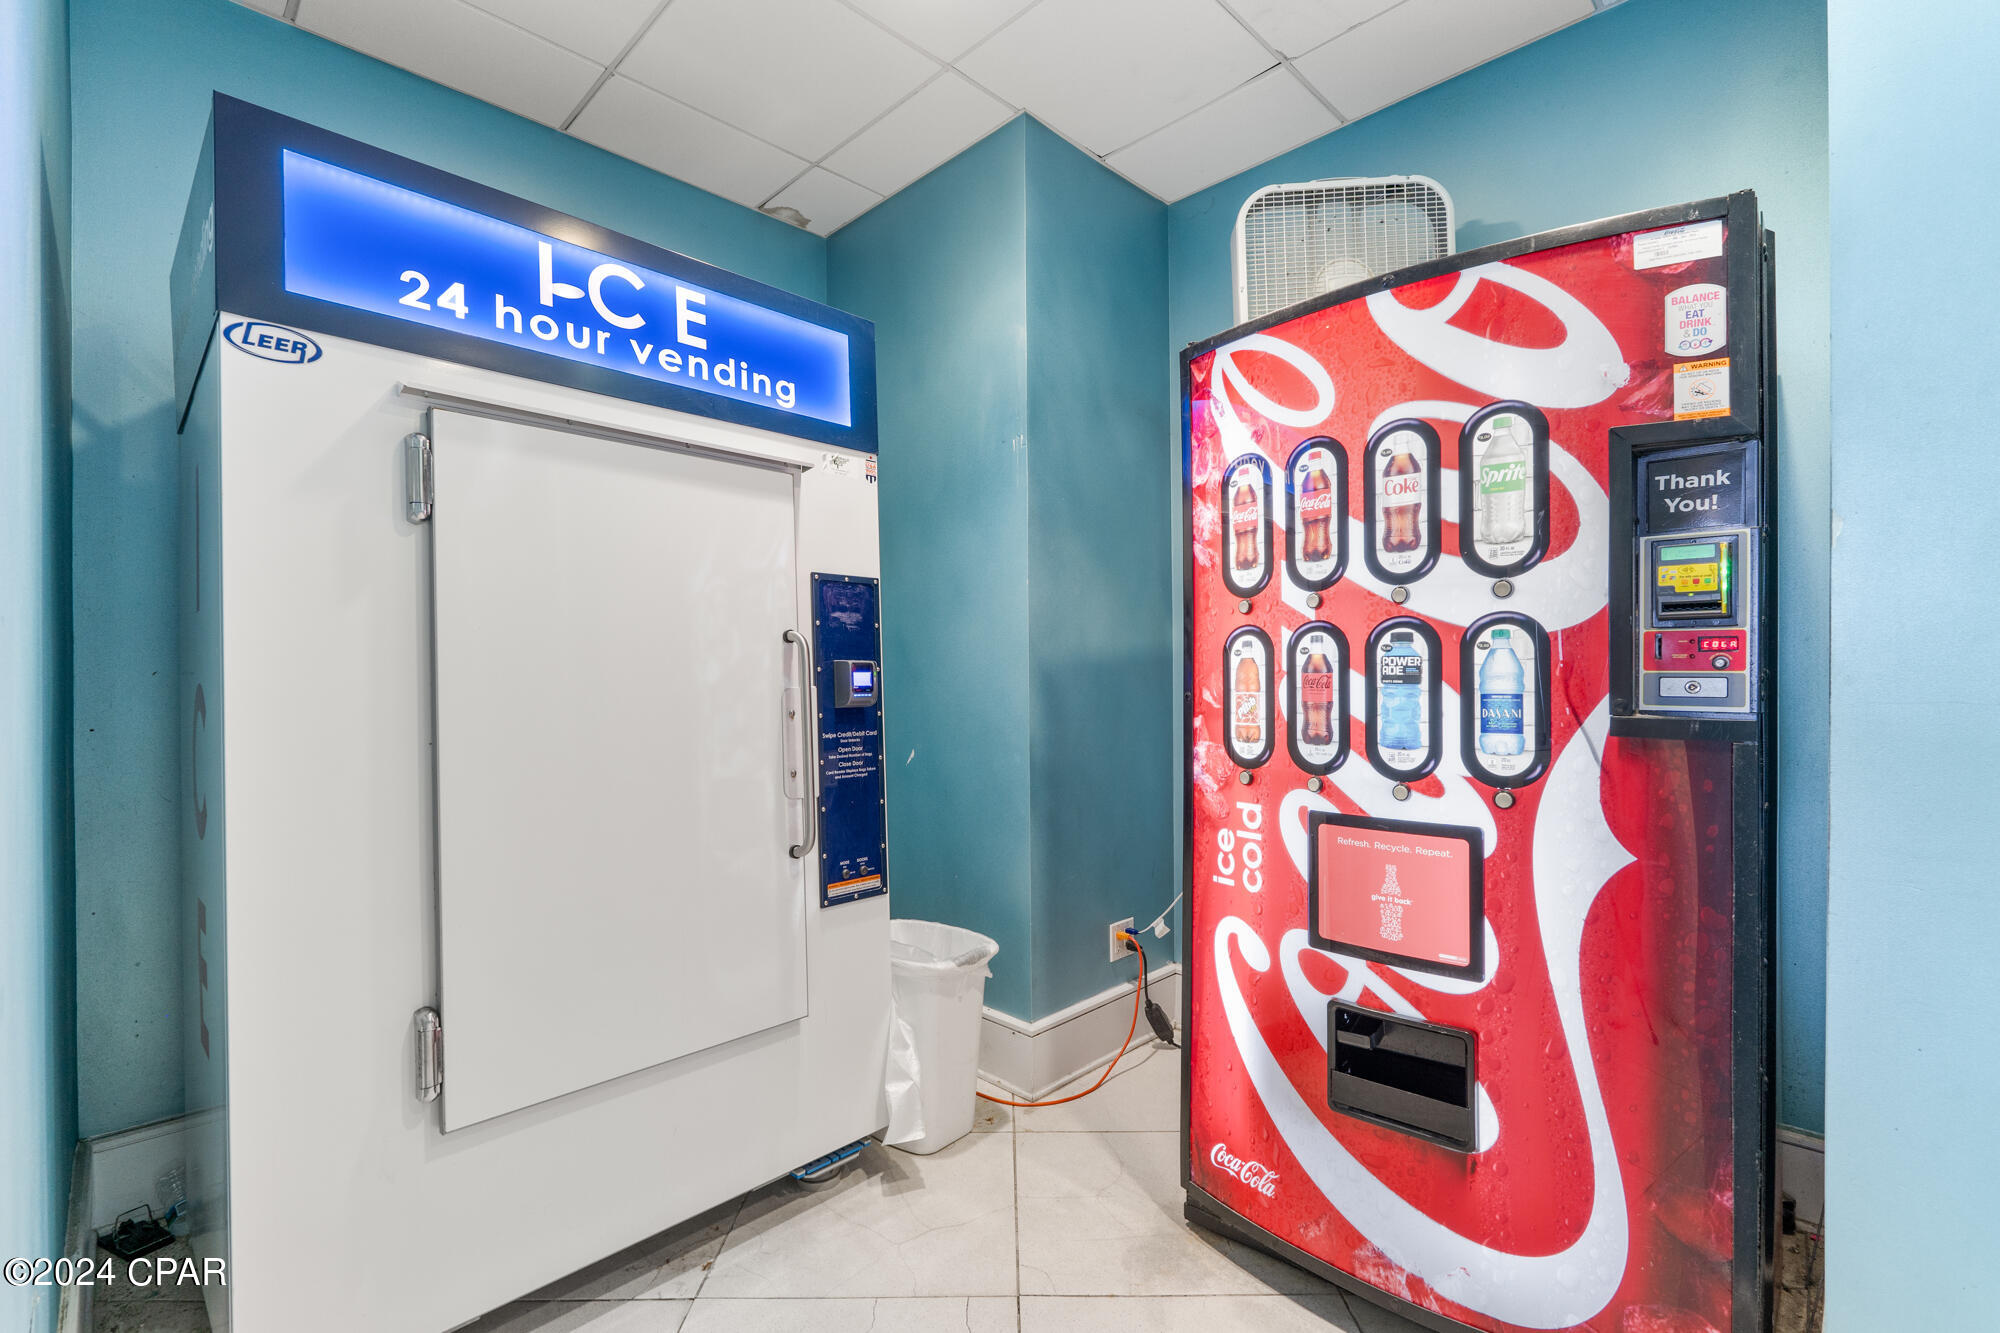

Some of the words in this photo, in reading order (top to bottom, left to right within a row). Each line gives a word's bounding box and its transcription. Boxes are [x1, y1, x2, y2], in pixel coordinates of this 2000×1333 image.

[538, 240, 708, 351] ICE
[1671, 290, 1721, 306] BALANCE
[1679, 317, 1712, 330] DRINK
[1685, 308, 1705, 320] EAT
[398, 269, 469, 320] 24
[495, 293, 611, 355] hour
[629, 338, 796, 409] vending
[1692, 326, 1707, 337] DO
[241, 322, 307, 363] LEER
[1690, 360, 1727, 369] WARNING
[1480, 463, 1526, 489] Sprite
[1654, 469, 1732, 491] Thank
[1384, 478, 1419, 497] Coke
[1299, 493, 1331, 512] Coca-Cola
[1664, 494, 1719, 513] You!
[1382, 656, 1421, 666] POWER
[1382, 666, 1404, 676] ADE
[1303, 674, 1332, 689] Coca-Cola
[1482, 707, 1522, 719] DASANI
[822, 732, 836, 740] Swipe
[1236, 801, 1263, 894] cold
[1337, 836, 1371, 848] Refresh.
[1374, 841, 1413, 854] Recycle.
[1415, 846, 1454, 858] Repeat.
[1212, 827, 1236, 887] ice
[1371, 893, 1386, 901] give
[1394, 896, 1411, 905] back
[1210, 1142, 1280, 1198] Coca-Cola
